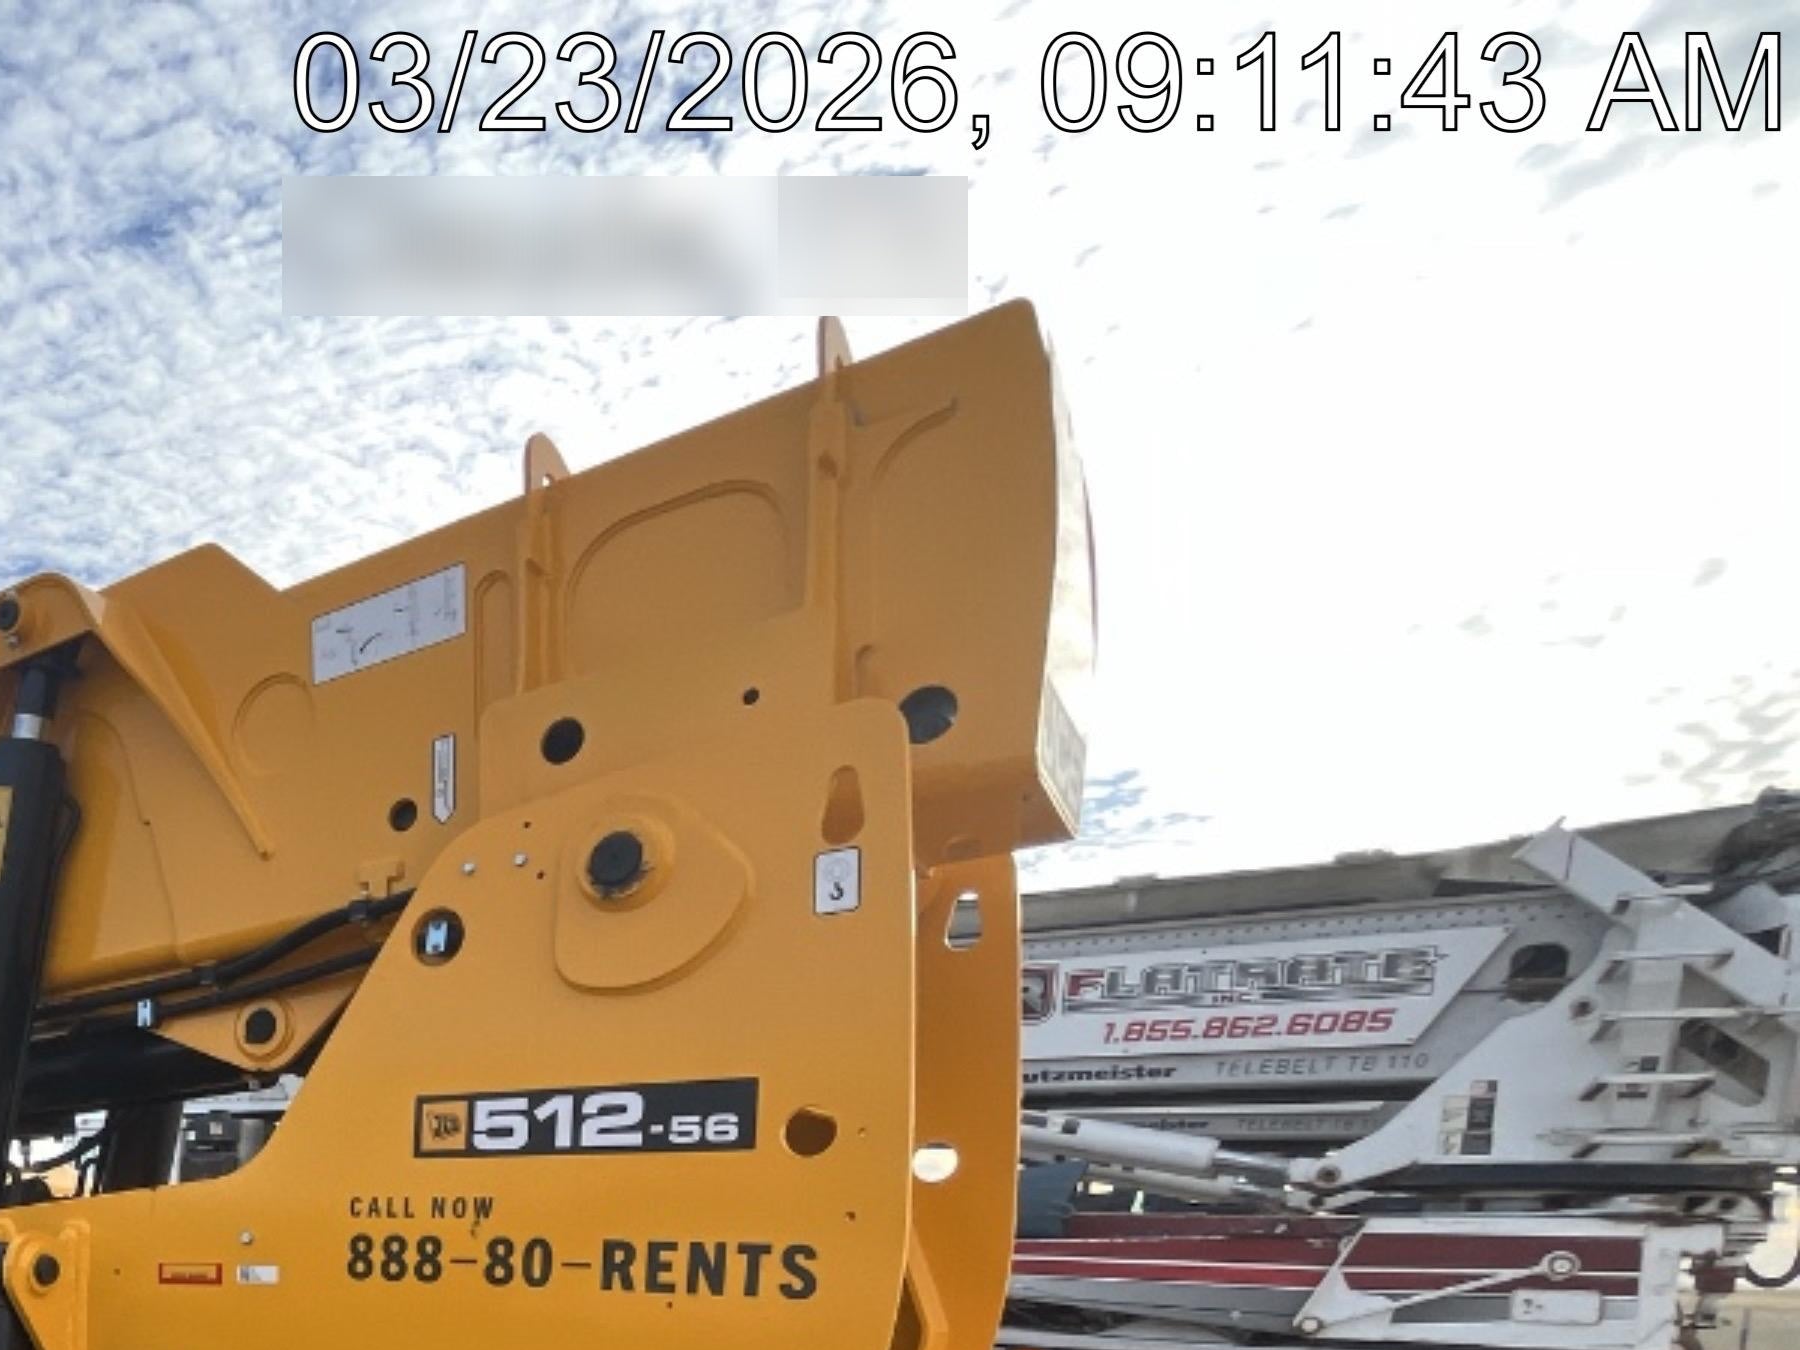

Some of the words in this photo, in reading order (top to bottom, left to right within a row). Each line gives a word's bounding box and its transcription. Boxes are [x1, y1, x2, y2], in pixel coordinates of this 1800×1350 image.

[1103, 1007, 1398, 1044] 1.855.862.6085
[1022, 1064, 1177, 1084] utzmeister
[1215, 1055, 1338, 1077] TELEBELT
[471, 1090, 741, 1151] 512-56
[349, 1197, 416, 1219] CALL
[430, 1197, 495, 1220] NOW
[346, 1232, 819, 1300] 888-80-RENTS
